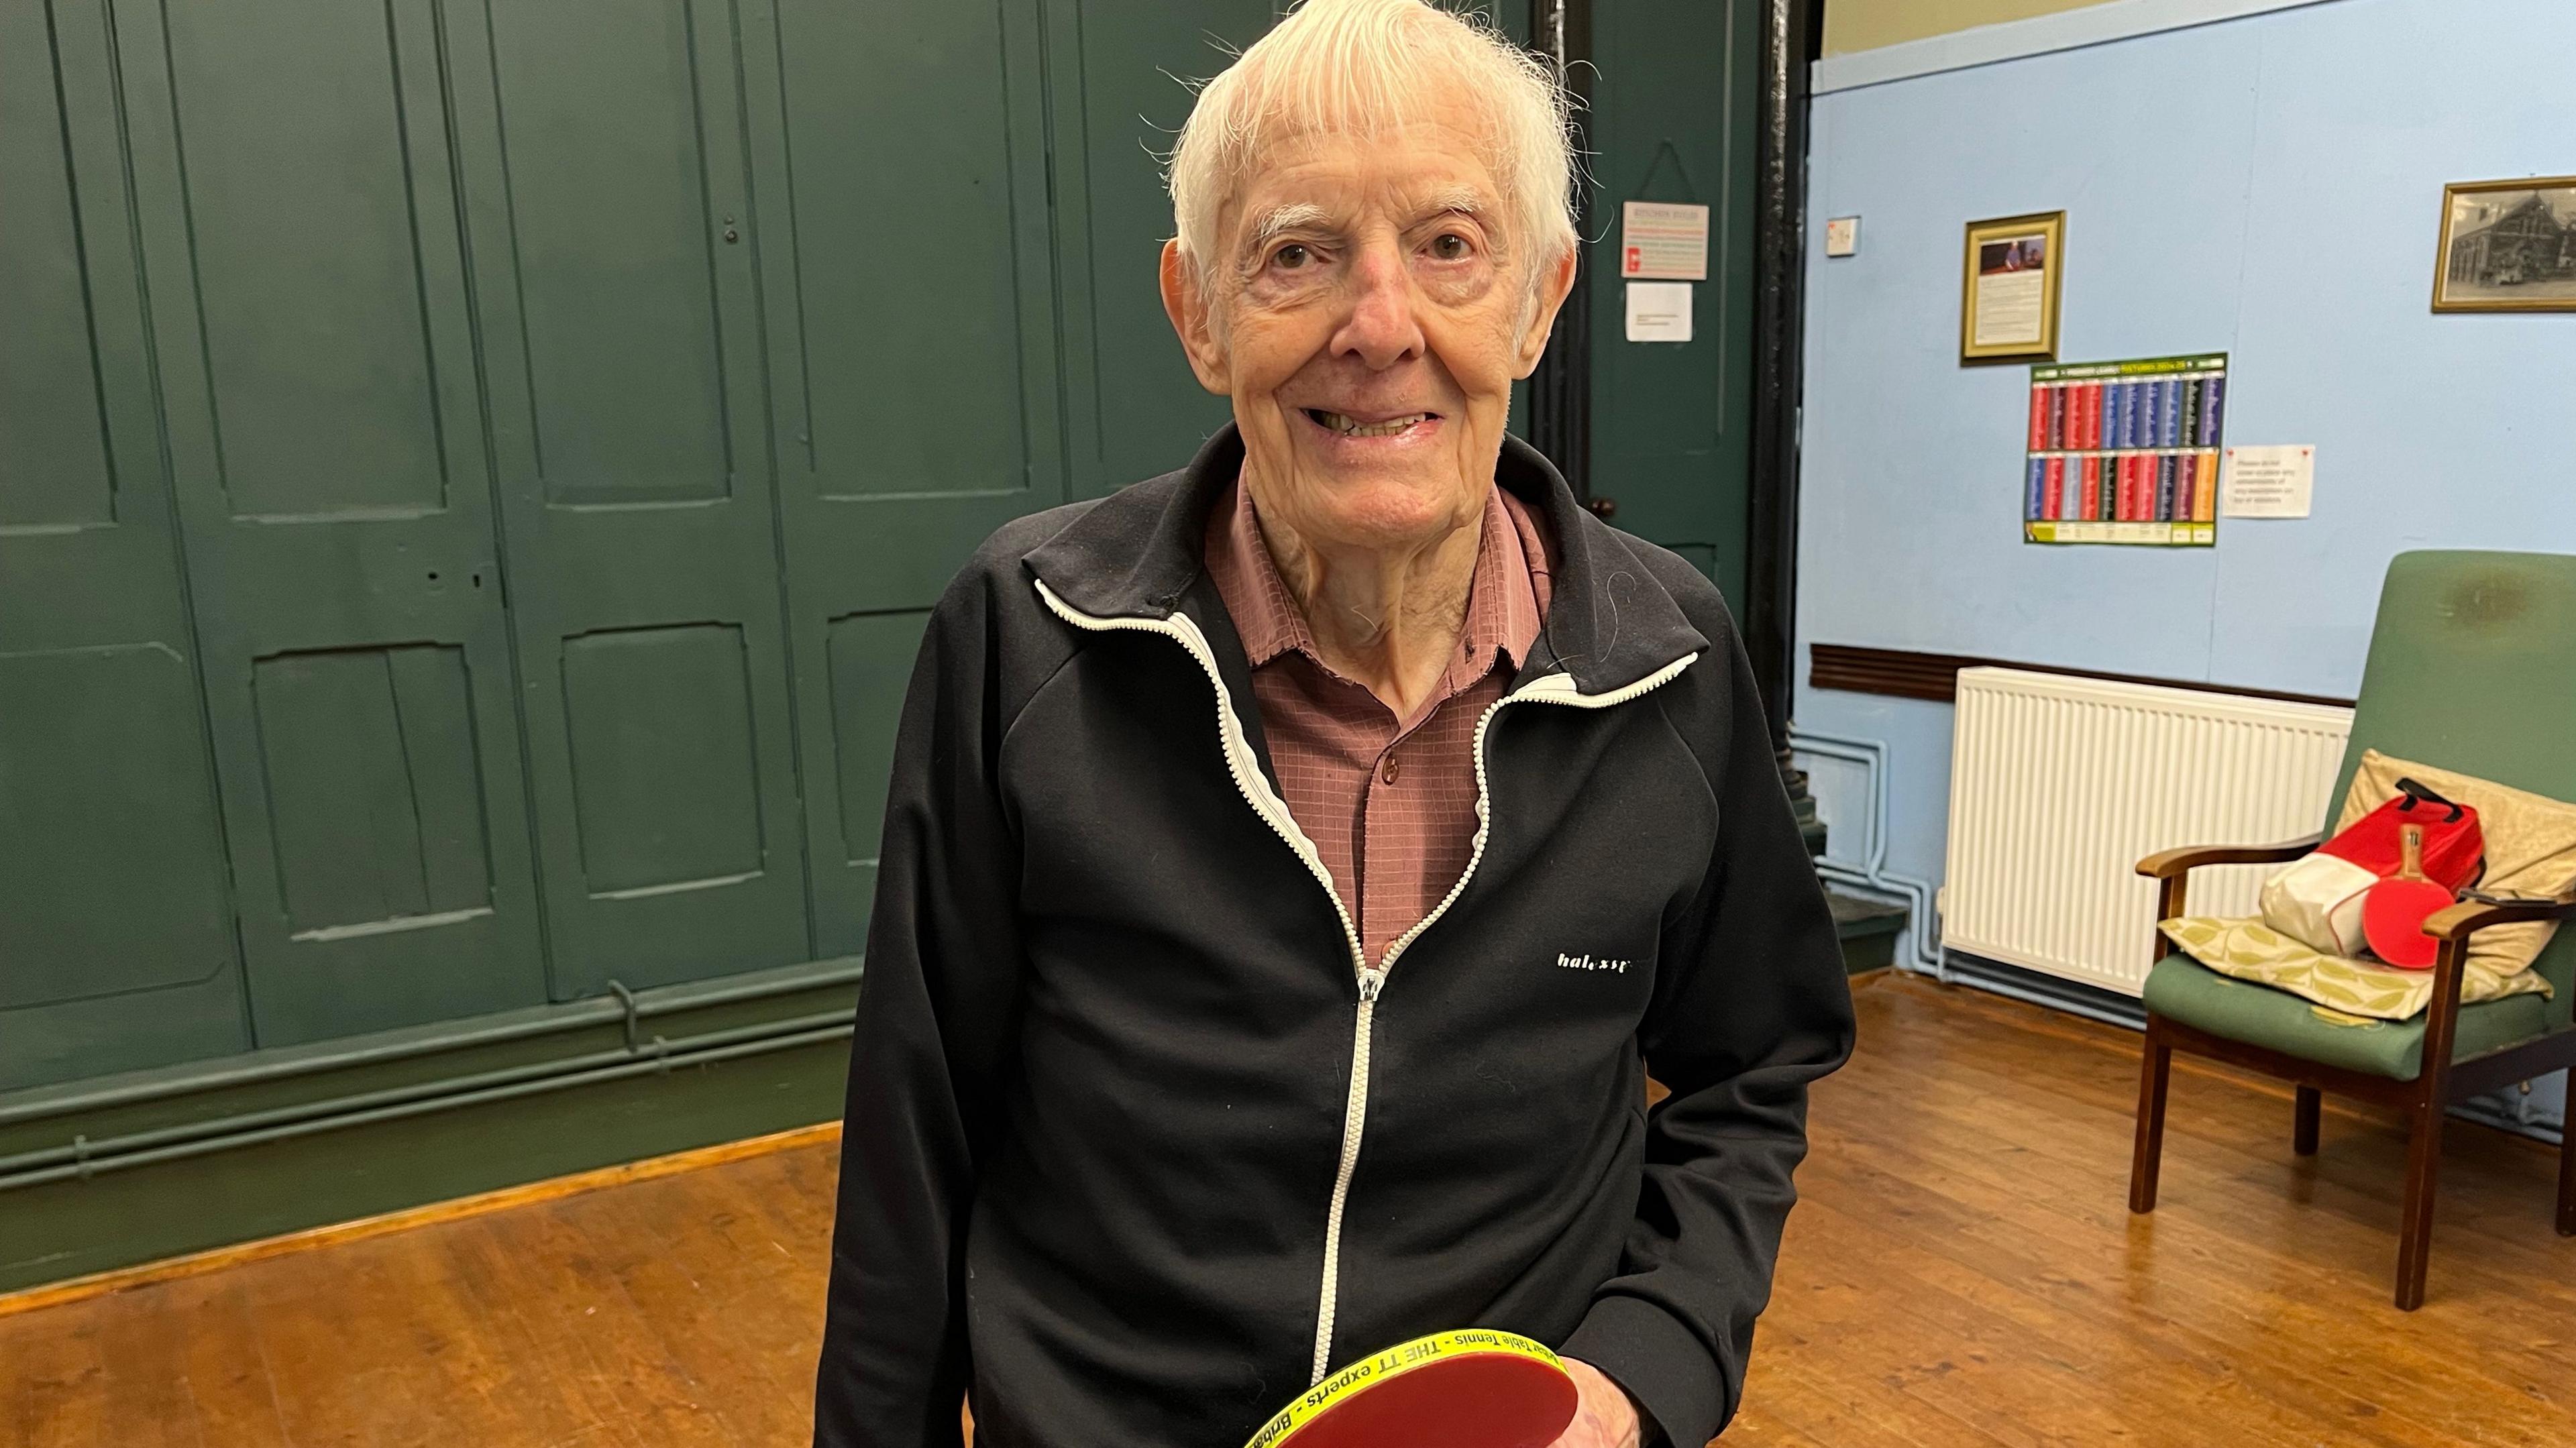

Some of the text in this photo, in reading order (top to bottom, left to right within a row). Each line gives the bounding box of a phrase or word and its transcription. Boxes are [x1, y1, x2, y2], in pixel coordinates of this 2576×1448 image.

[1454, 1333, 1501, 1347] Tennis
[1502, 1335, 1532, 1352] Table
[1405, 1341, 1442, 1363] THE
[1378, 1353, 1401, 1374] TT
[1307, 1365, 1371, 1408] experts
